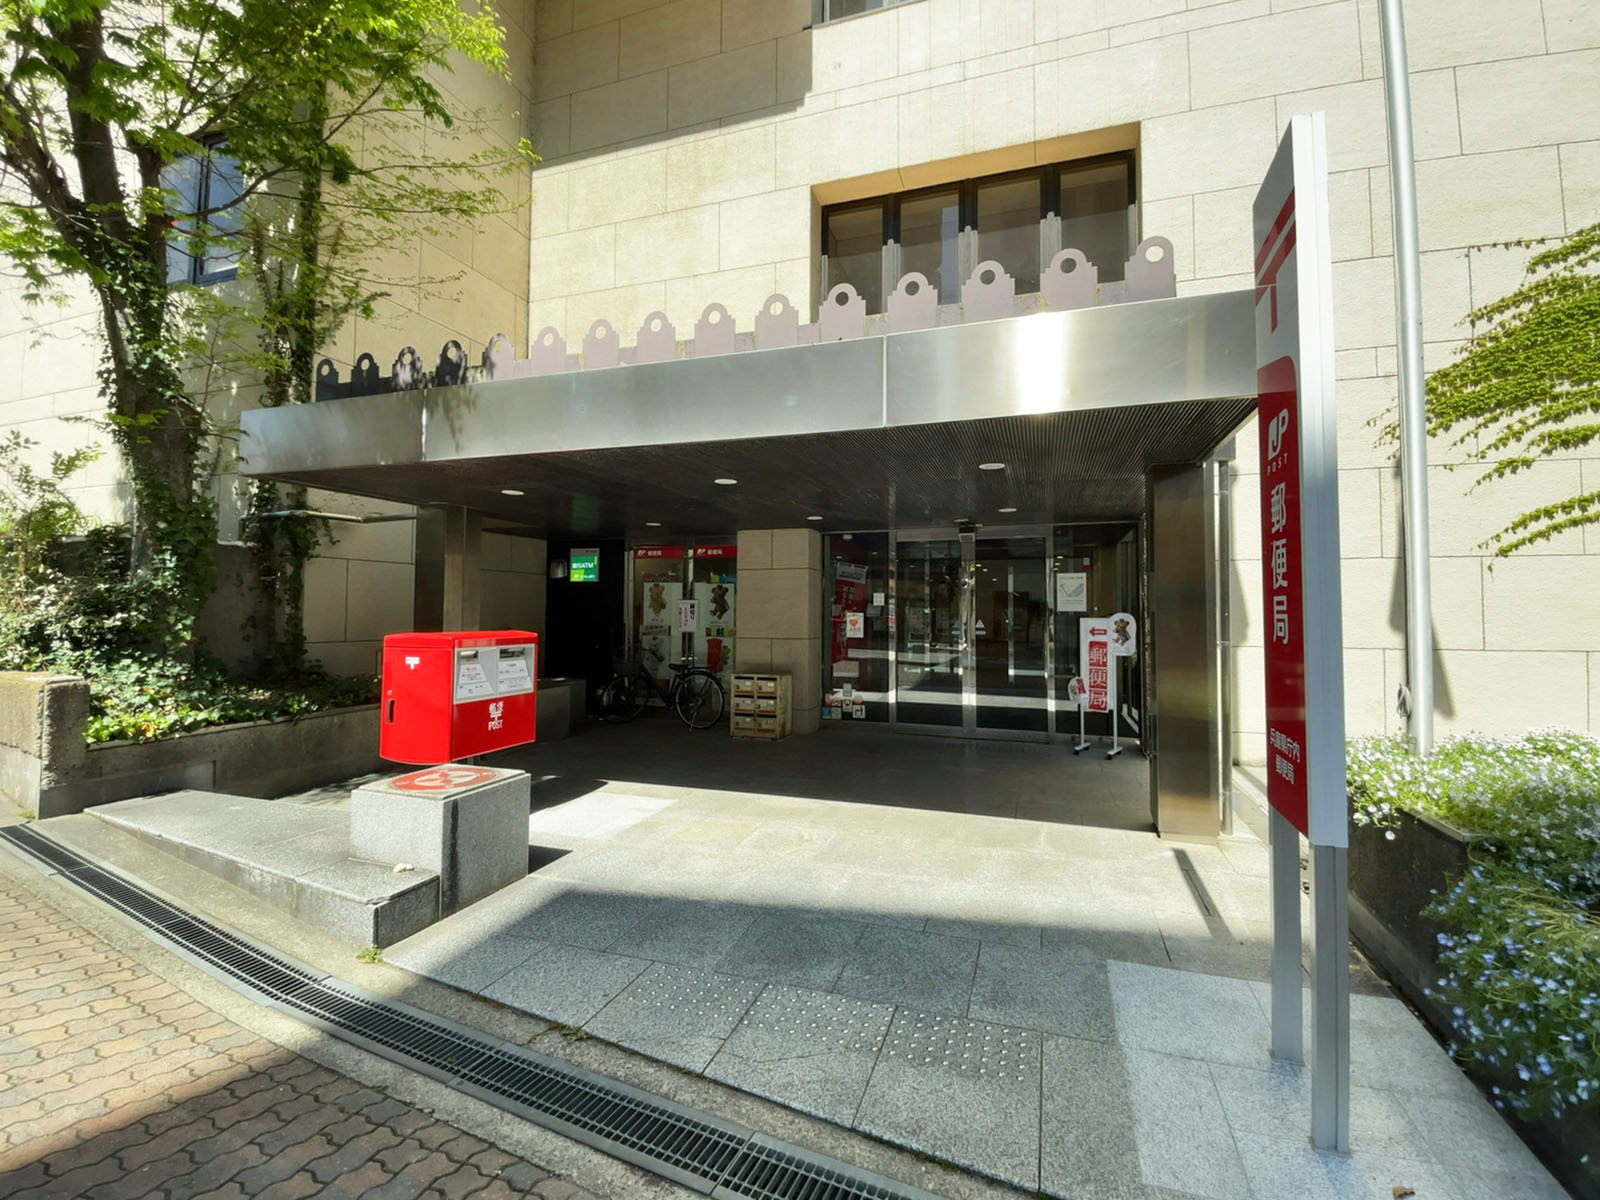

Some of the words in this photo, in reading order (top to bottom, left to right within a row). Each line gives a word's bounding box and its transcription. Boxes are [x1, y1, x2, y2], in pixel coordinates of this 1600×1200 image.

[1267, 452, 1289, 477] POST
[1271, 481, 1289, 645] 郵便局
[1089, 648, 1108, 709] 郵便局
[488, 719, 504, 731] POST
[1270, 727, 1301, 763] 兵庫県庁内
[1275, 754, 1295, 785] 郵便局
